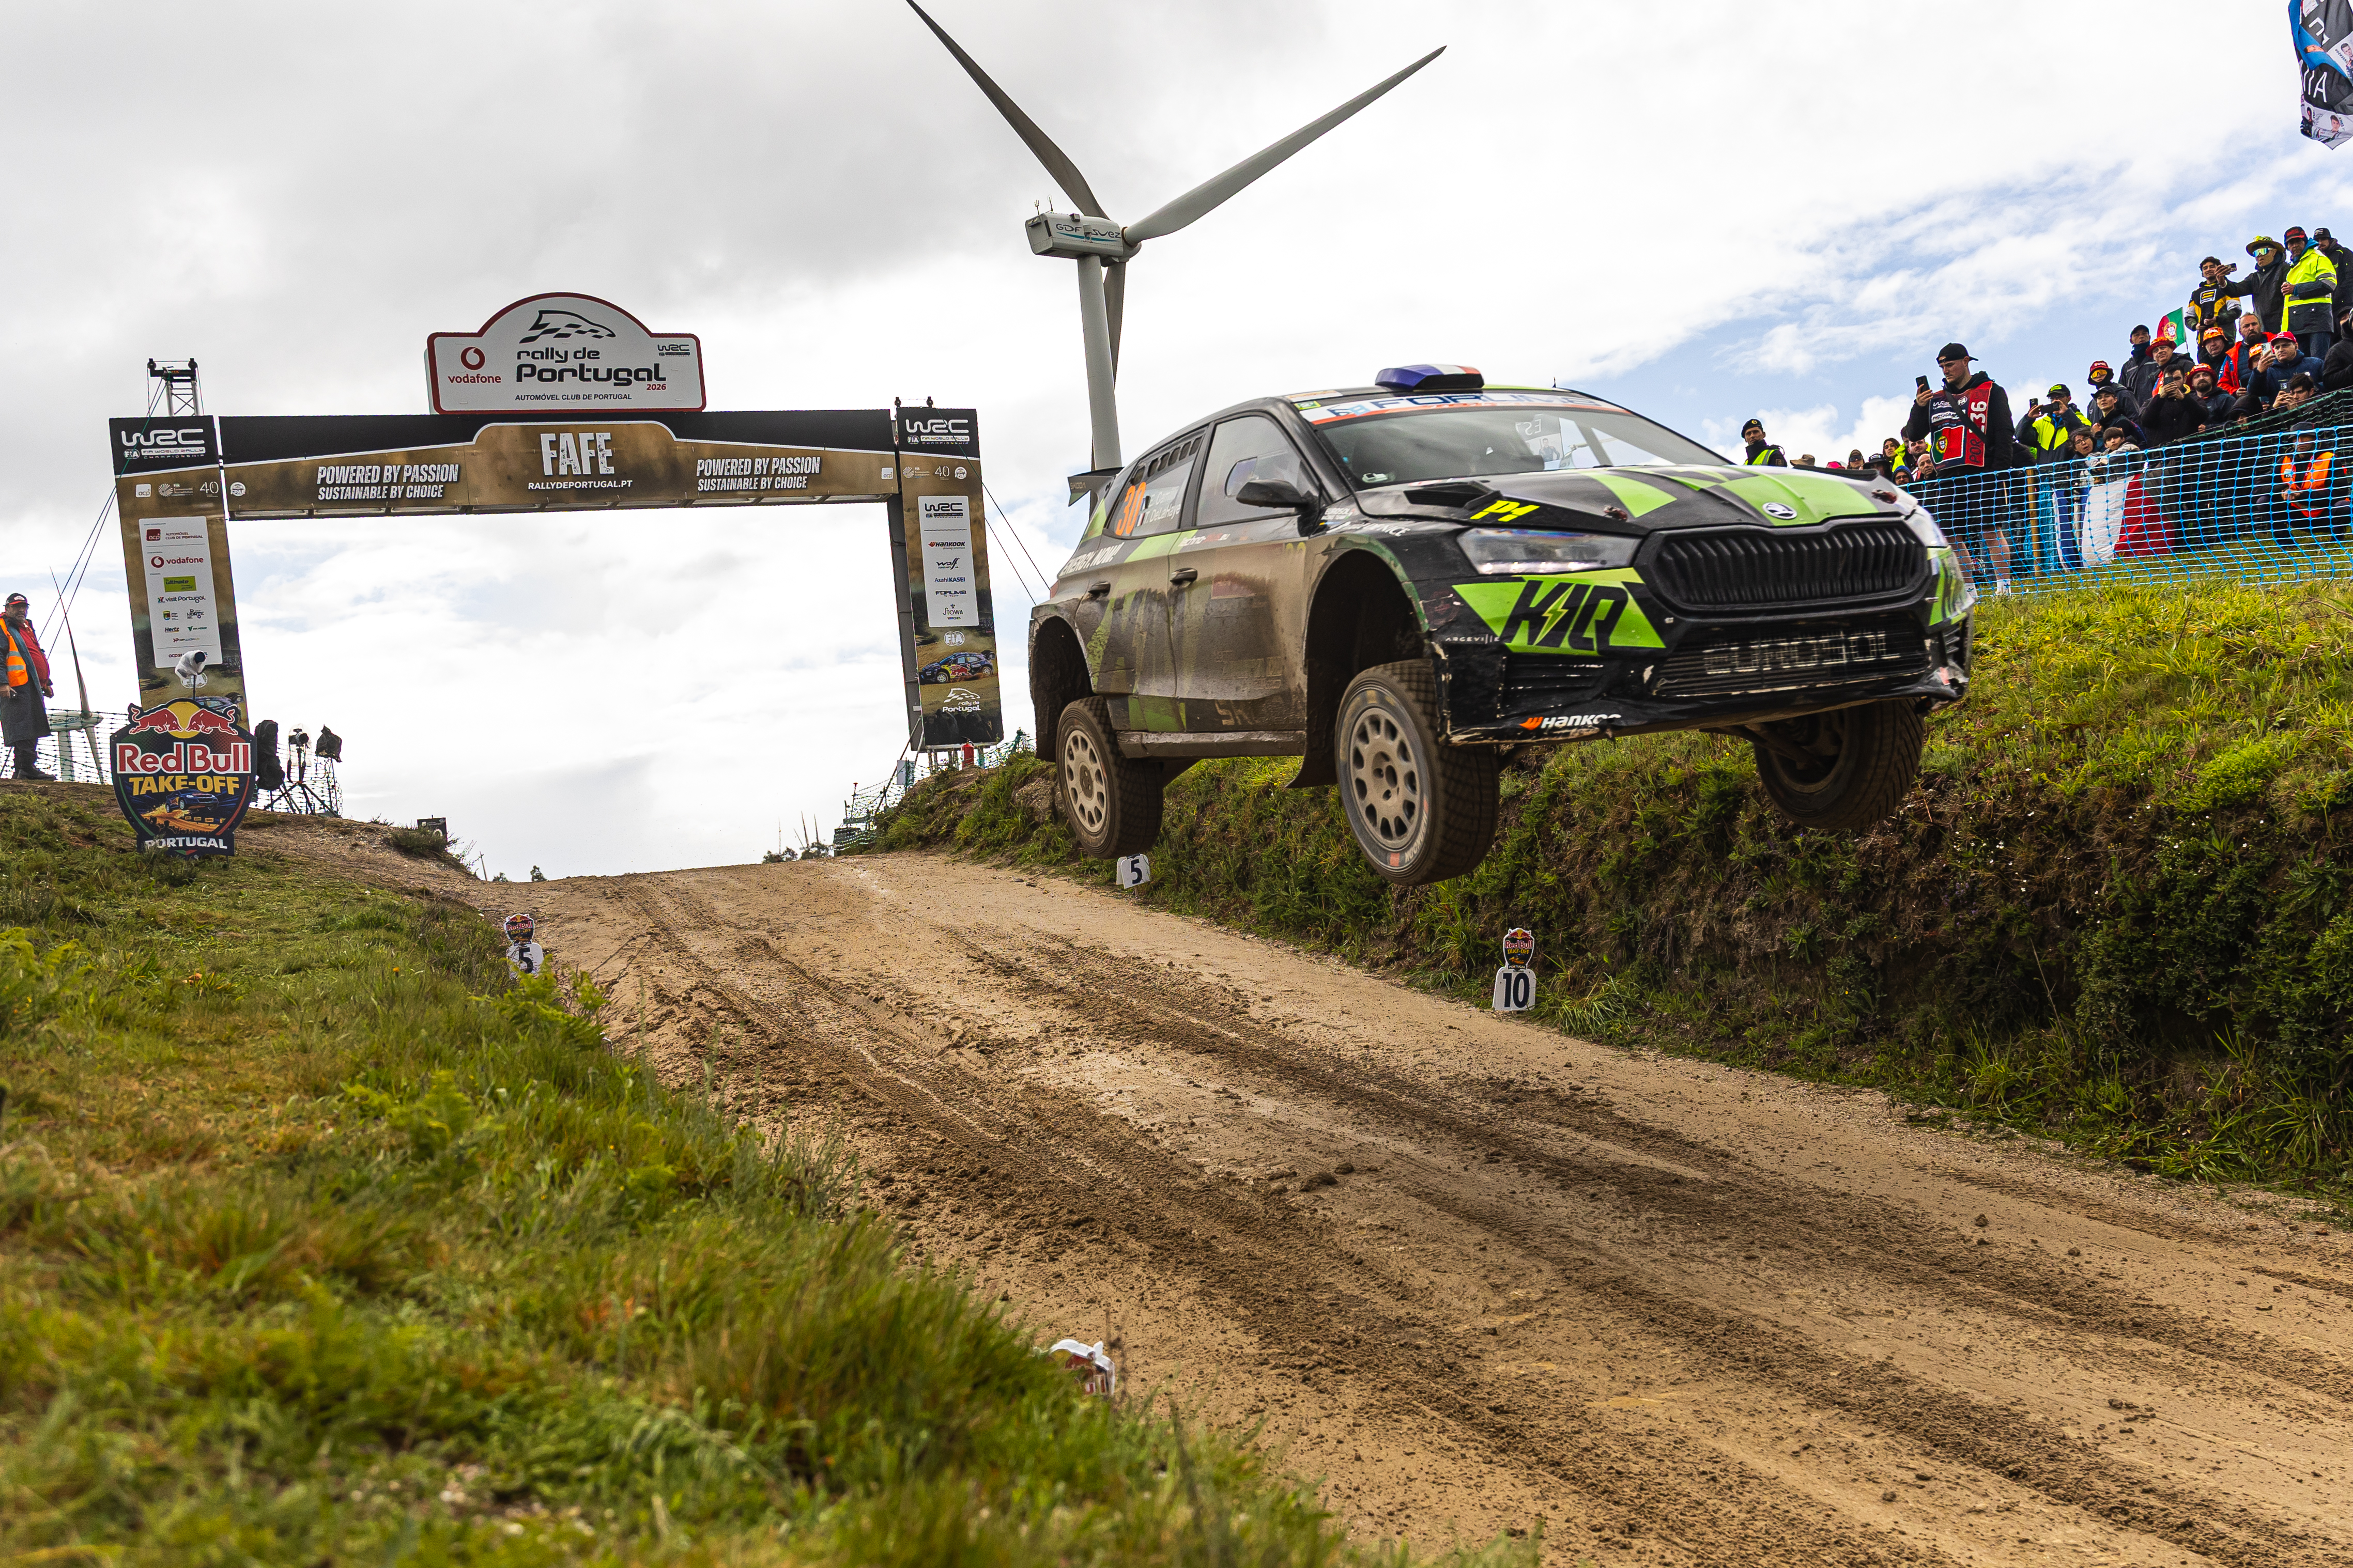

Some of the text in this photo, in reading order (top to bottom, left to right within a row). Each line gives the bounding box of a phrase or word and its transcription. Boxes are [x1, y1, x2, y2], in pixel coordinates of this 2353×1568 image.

[1056, 223, 1082, 232] GDF
[517, 347, 599, 363] rally de
[448, 374, 501, 384] vodafone
[517, 363, 666, 386] Portugal
[905, 419, 969, 433] WRC
[121, 429, 205, 446] WRC
[540, 432, 615, 476] FAFE
[316, 463, 459, 485] POWERED BY PASSION
[697, 457, 821, 477] POWERED BY PASSION
[935, 466, 950, 477] 40
[199, 481, 219, 493] 40
[528, 480, 633, 490] RALLYDEPORTUGAL.PT
[697, 476, 807, 491] SUSTAINABLE BY CHOICE
[318, 485, 444, 500] SUSTAINABLE BY CHOICE
[924, 503, 963, 511] WRC
[1115, 482, 1147, 536] 30
[946, 634, 963, 643] FIA
[117, 742, 252, 774] Red Bull
[129, 775, 240, 796] TAKE-OFF
[145, 836, 228, 849] PORTUGAL
[1131, 859, 1143, 884] 5
[1505, 940, 1533, 949] Red Bull
[519, 947, 533, 974] 5
[1503, 972, 1530, 1008] 10
